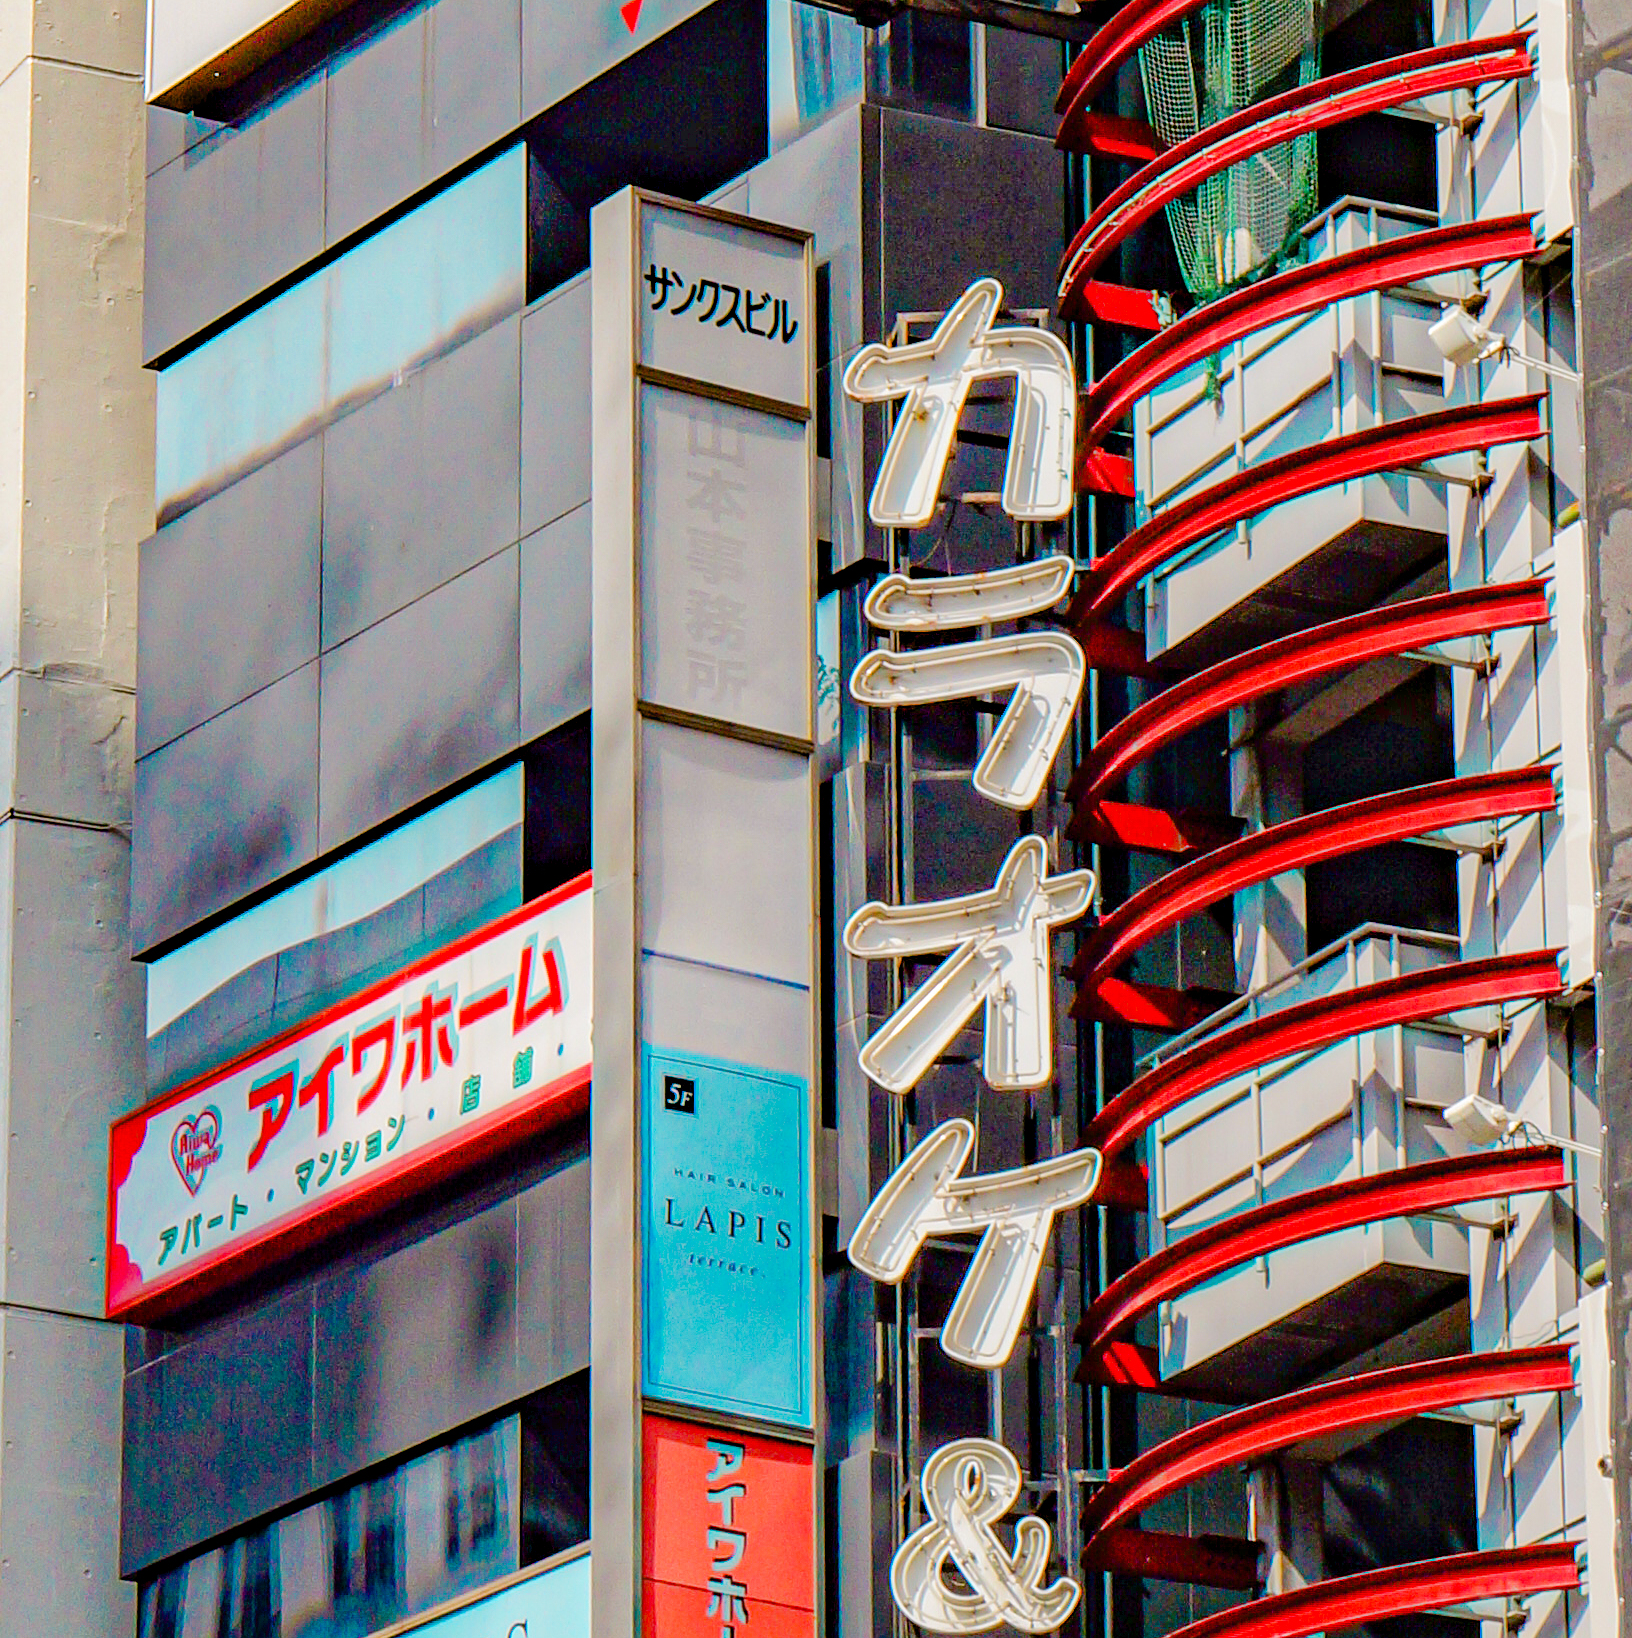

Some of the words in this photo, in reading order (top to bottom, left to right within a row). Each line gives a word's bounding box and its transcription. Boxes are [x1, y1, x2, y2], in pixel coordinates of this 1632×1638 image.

[643, 264, 799, 346] サンクスビル
[247, 931, 570, 1173] アイワホーム
[666, 1082, 693, 1107] 5F
[673, 1167, 717, 1184] HAIR
[725, 1178, 786, 1200] SALON
[664, 1197, 793, 1250] LAPIS
